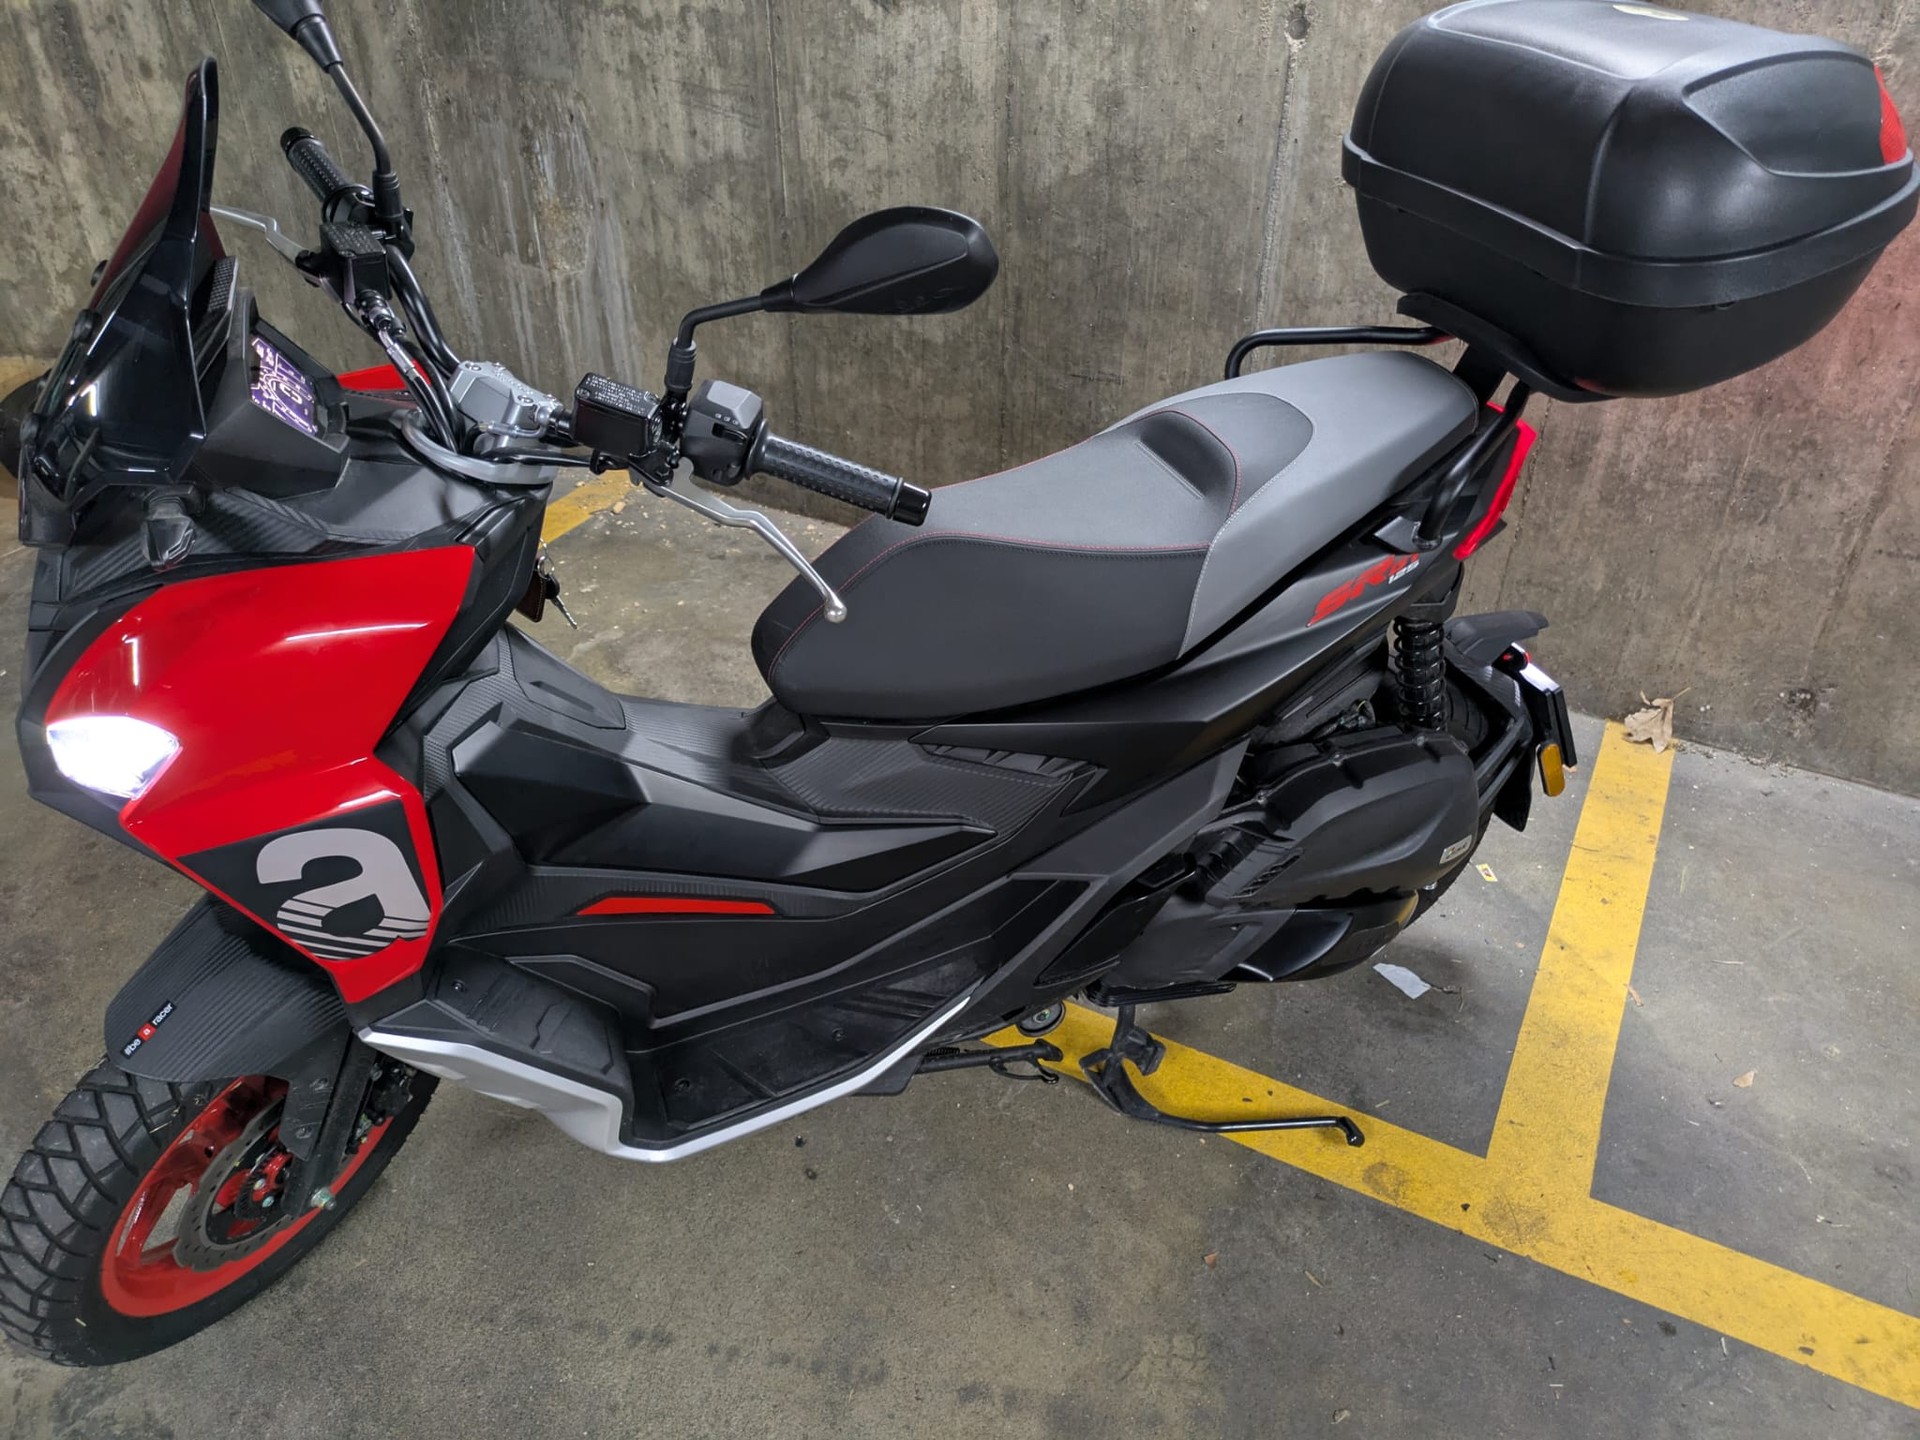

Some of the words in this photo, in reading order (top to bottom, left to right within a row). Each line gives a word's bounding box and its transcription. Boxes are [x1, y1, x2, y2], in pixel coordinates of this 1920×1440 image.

[256, 828, 432, 960] a
[124, 1038, 142, 1056] #be
[152, 1002, 173, 1026] racer
